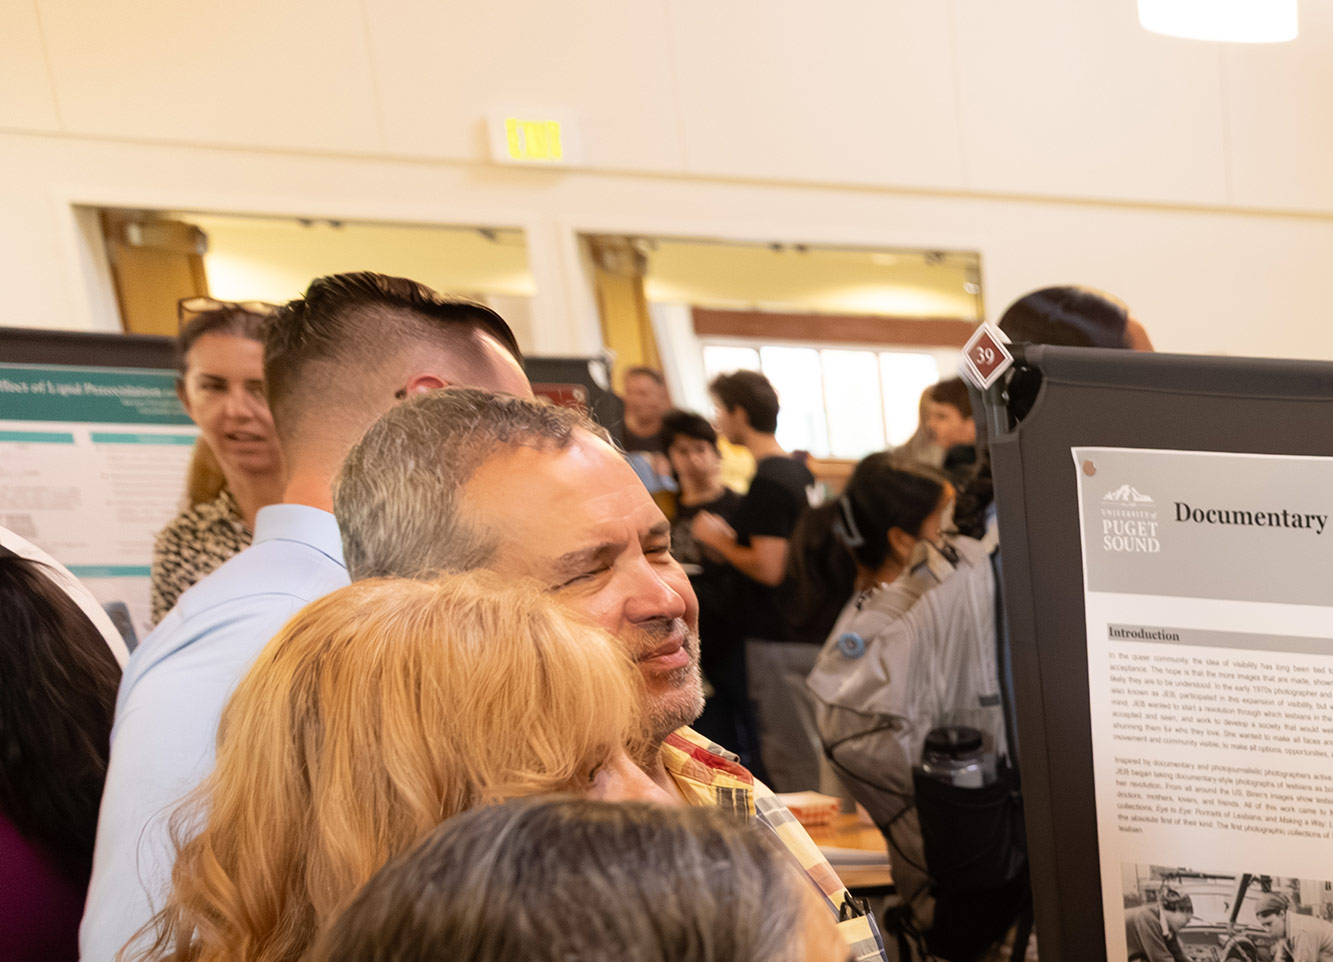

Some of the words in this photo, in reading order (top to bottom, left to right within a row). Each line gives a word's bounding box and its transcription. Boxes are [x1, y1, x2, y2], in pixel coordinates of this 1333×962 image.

[977, 346, 995, 365] 39
[1174, 502, 1328, 534] Documentary
[1103, 519, 1159, 536] PUGET
[1103, 537, 1160, 552] SOUND
[1109, 626, 1180, 642] Introduction
